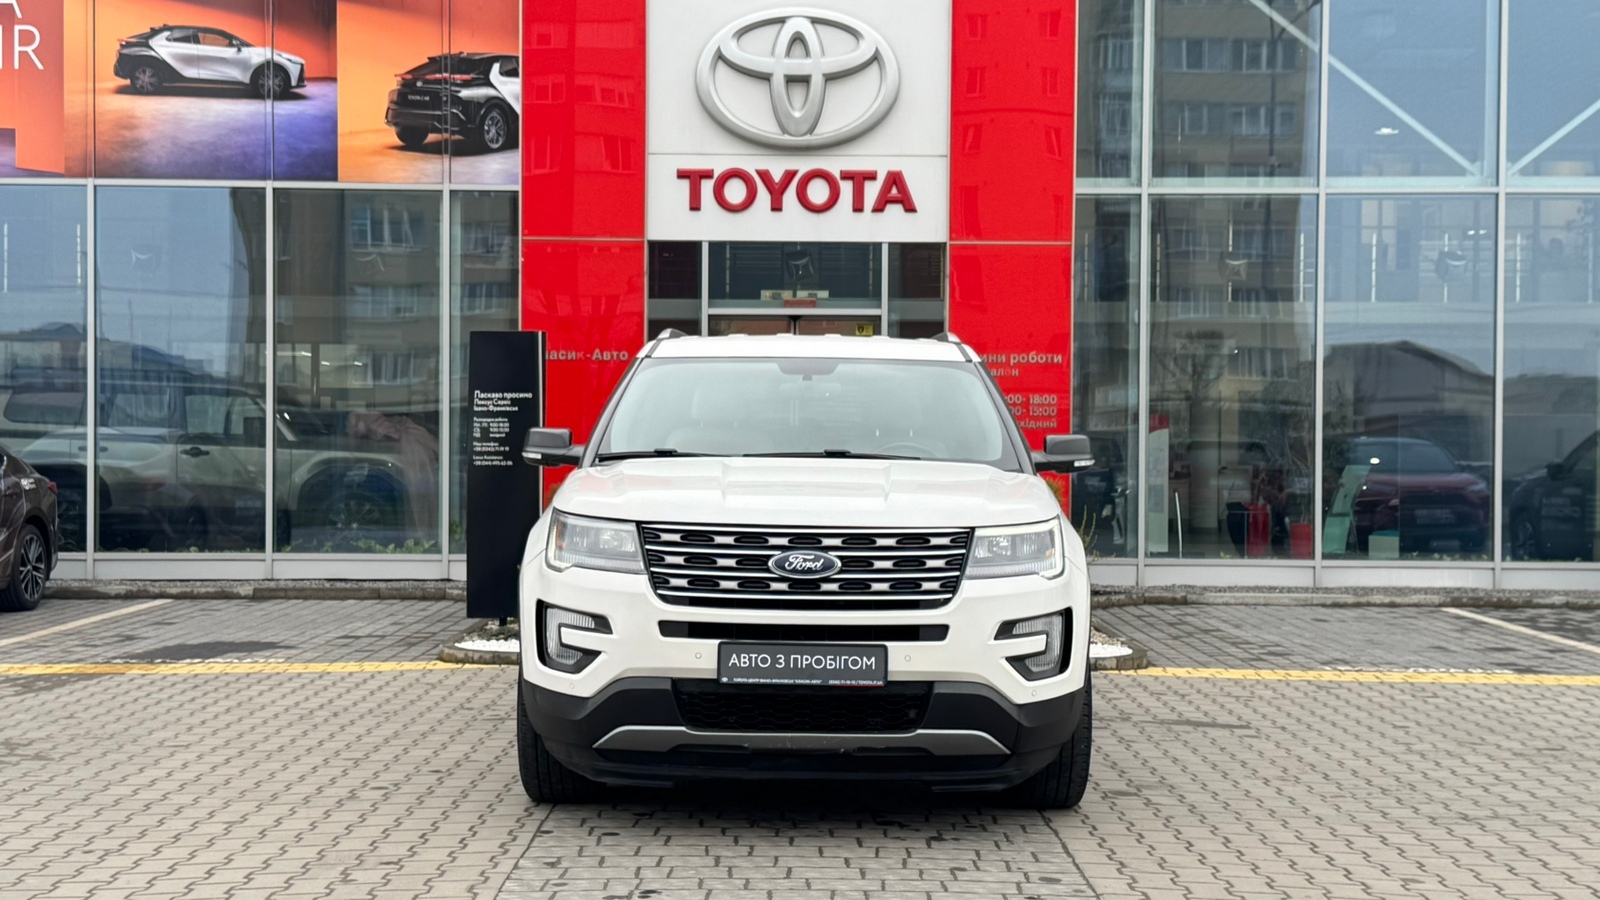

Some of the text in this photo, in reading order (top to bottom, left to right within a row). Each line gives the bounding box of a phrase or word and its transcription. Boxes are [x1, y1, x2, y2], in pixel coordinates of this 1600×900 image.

[676, 167, 918, 214] TOYOTA
[1010, 351, 1062, 366] роботи
[1029, 394, 1057, 404] 18:00
[1029, 406, 1057, 416] 15:00
[785, 554, 825, 571] Ford
[728, 653, 876, 670] АВТО З ПРОБІГОМ
